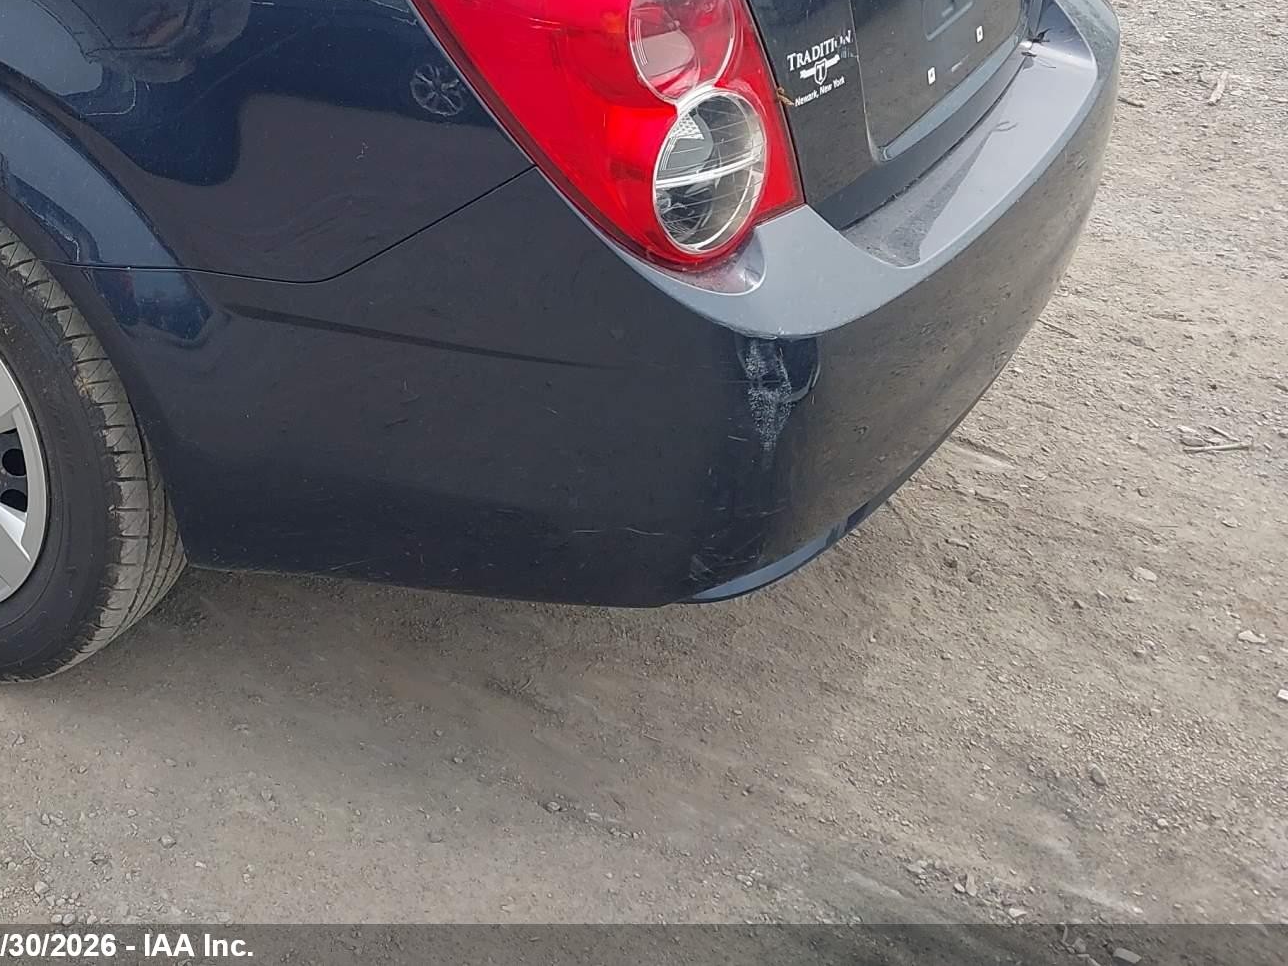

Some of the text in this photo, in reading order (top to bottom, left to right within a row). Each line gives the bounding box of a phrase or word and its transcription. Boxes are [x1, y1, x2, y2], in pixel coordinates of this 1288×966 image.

[795, 75, 845, 107] Newark, New York
